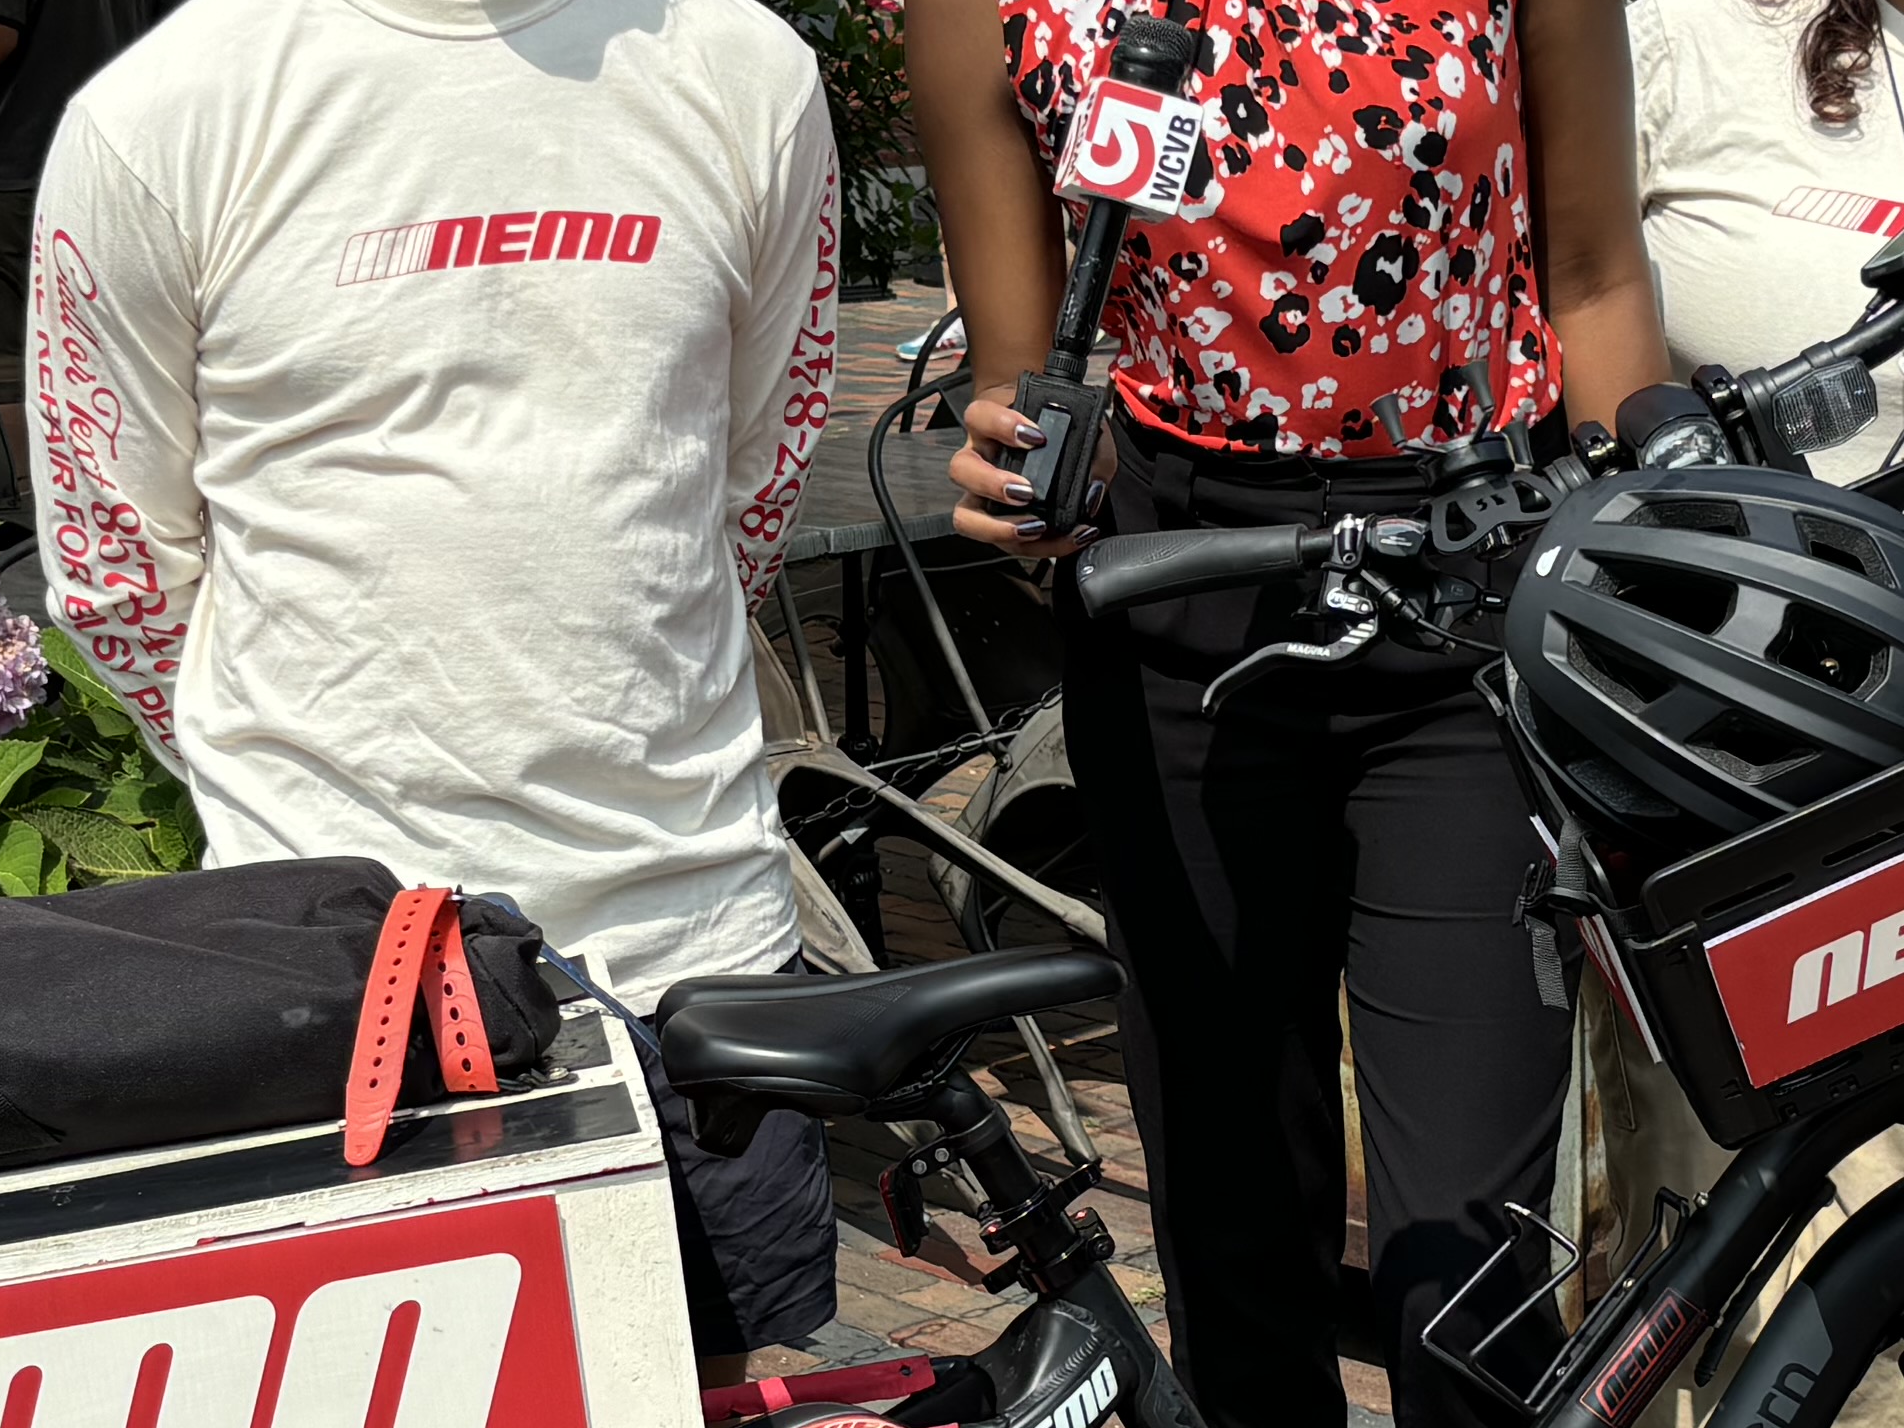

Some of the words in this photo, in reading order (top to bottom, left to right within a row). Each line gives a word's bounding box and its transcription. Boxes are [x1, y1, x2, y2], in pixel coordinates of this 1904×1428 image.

[1150, 115, 1197, 202] WCVB
[427, 211, 662, 270] NEMO
[53, 228, 103, 355] Call
[62, 336, 97, 387] or
[66, 386, 122, 492] Text
[54, 499, 94, 586] FOR
